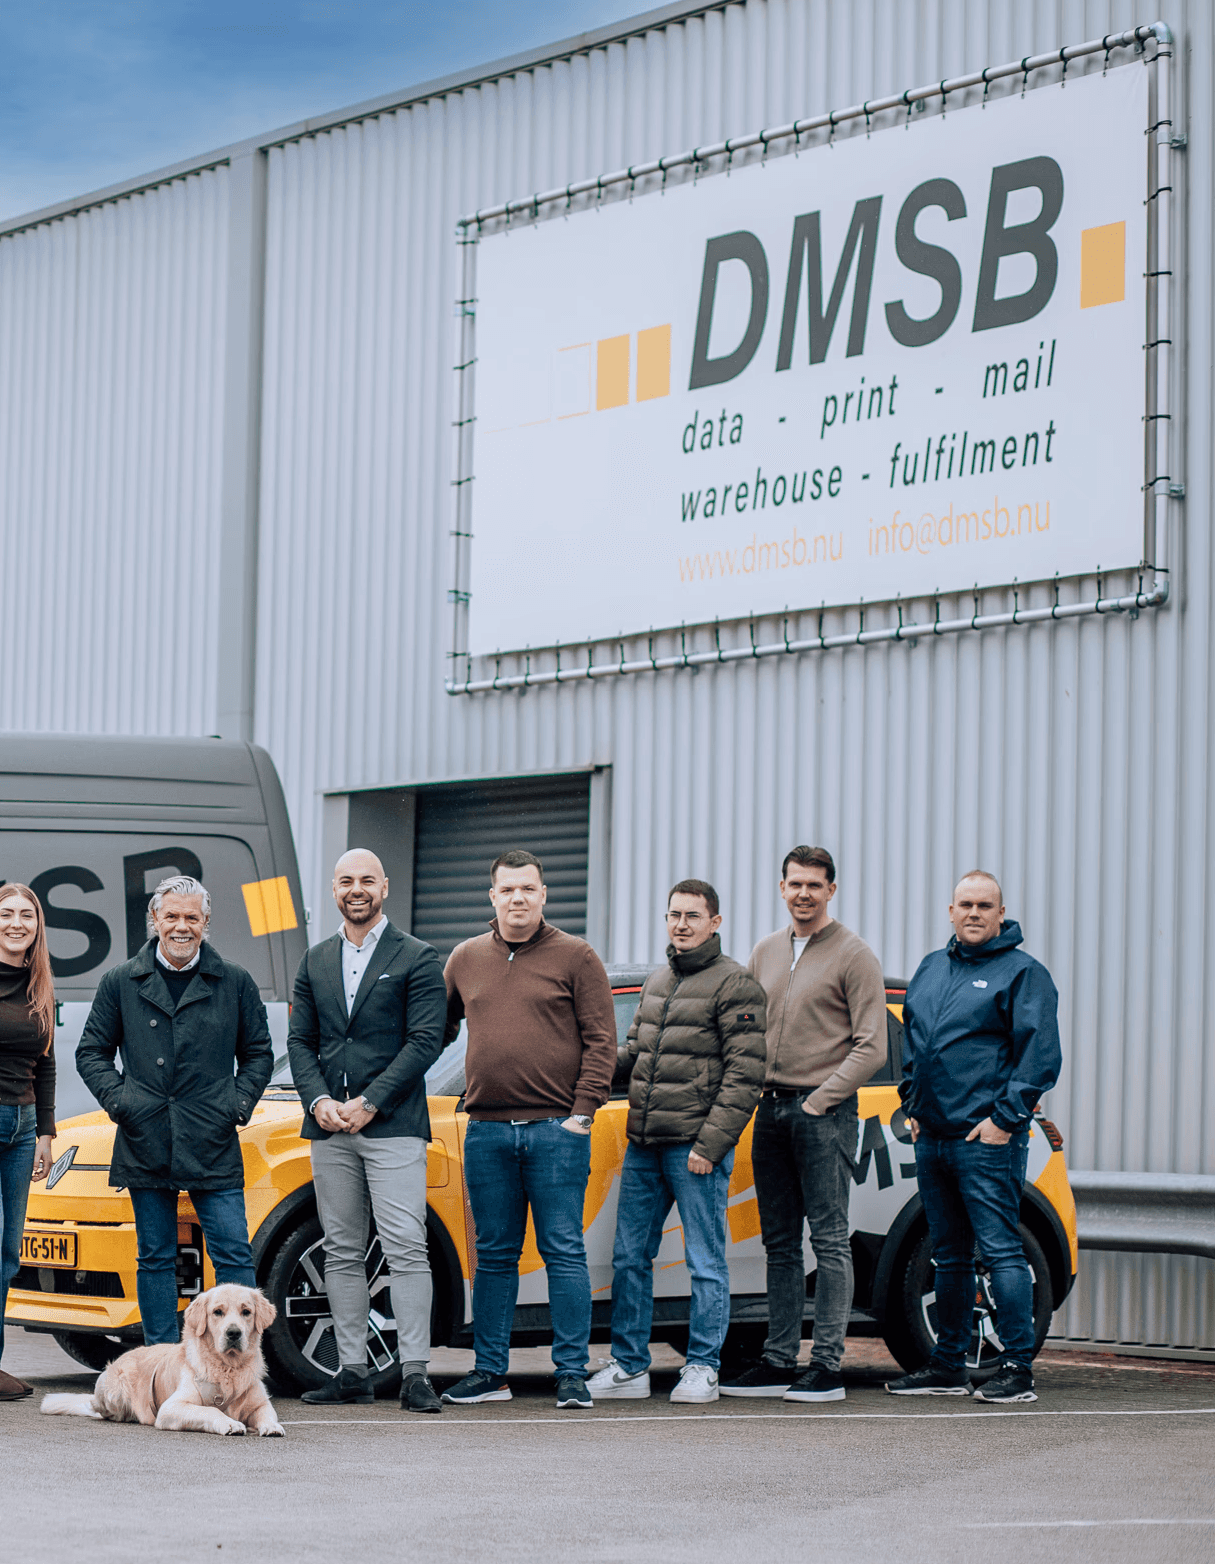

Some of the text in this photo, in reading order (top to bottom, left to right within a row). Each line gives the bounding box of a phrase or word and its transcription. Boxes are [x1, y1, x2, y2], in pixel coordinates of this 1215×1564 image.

[688, 155, 1064, 391] DMSB
[681, 409, 744, 454] data
[820, 374, 899, 440] print
[982, 338, 1057, 399] mail
[681, 465, 843, 522] warehouse
[889, 420, 1056, 489] fulfilment
[678, 495, 1051, 583] www.dmsb.nu info@dmsb.nu
